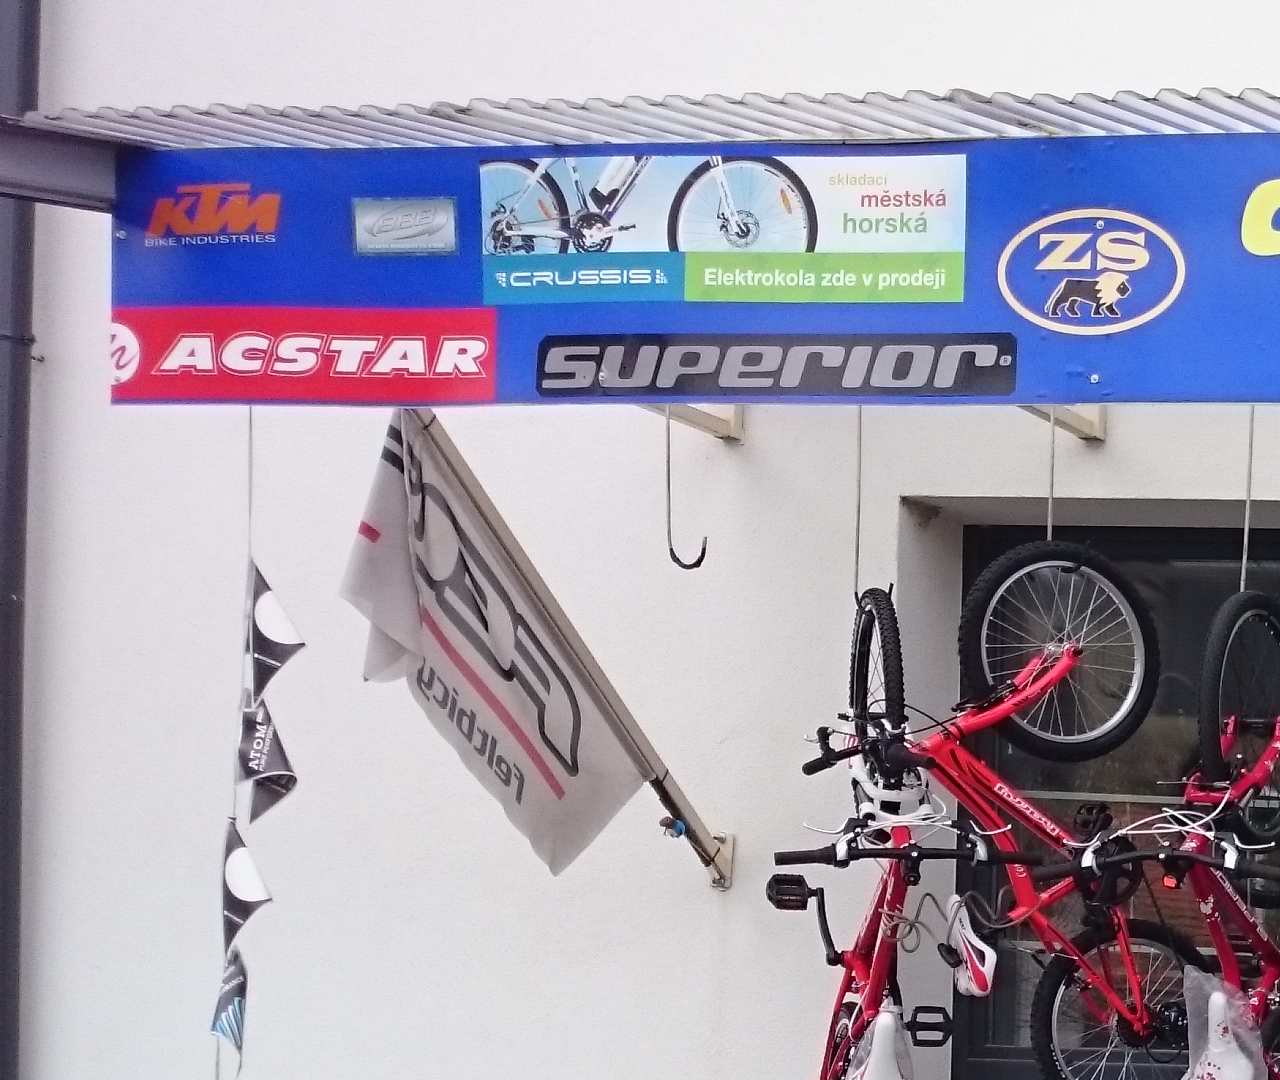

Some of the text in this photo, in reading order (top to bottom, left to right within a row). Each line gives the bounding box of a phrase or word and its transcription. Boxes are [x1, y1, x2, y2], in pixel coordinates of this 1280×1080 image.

[829, 173, 888, 186] skládací
[145, 182, 281, 236] KTM
[861, 189, 946, 208] městská
[843, 213, 928, 234] horská
[145, 234, 276, 246] BIKE INDUSTRIES
[1036, 231, 1151, 272] ZS
[510, 269, 651, 286] CRUSSIS
[705, 267, 945, 291] Elektrokola zde v prodeji
[152, 332, 488, 378] ACSTAR
[249, 722, 268, 771] ATOM
